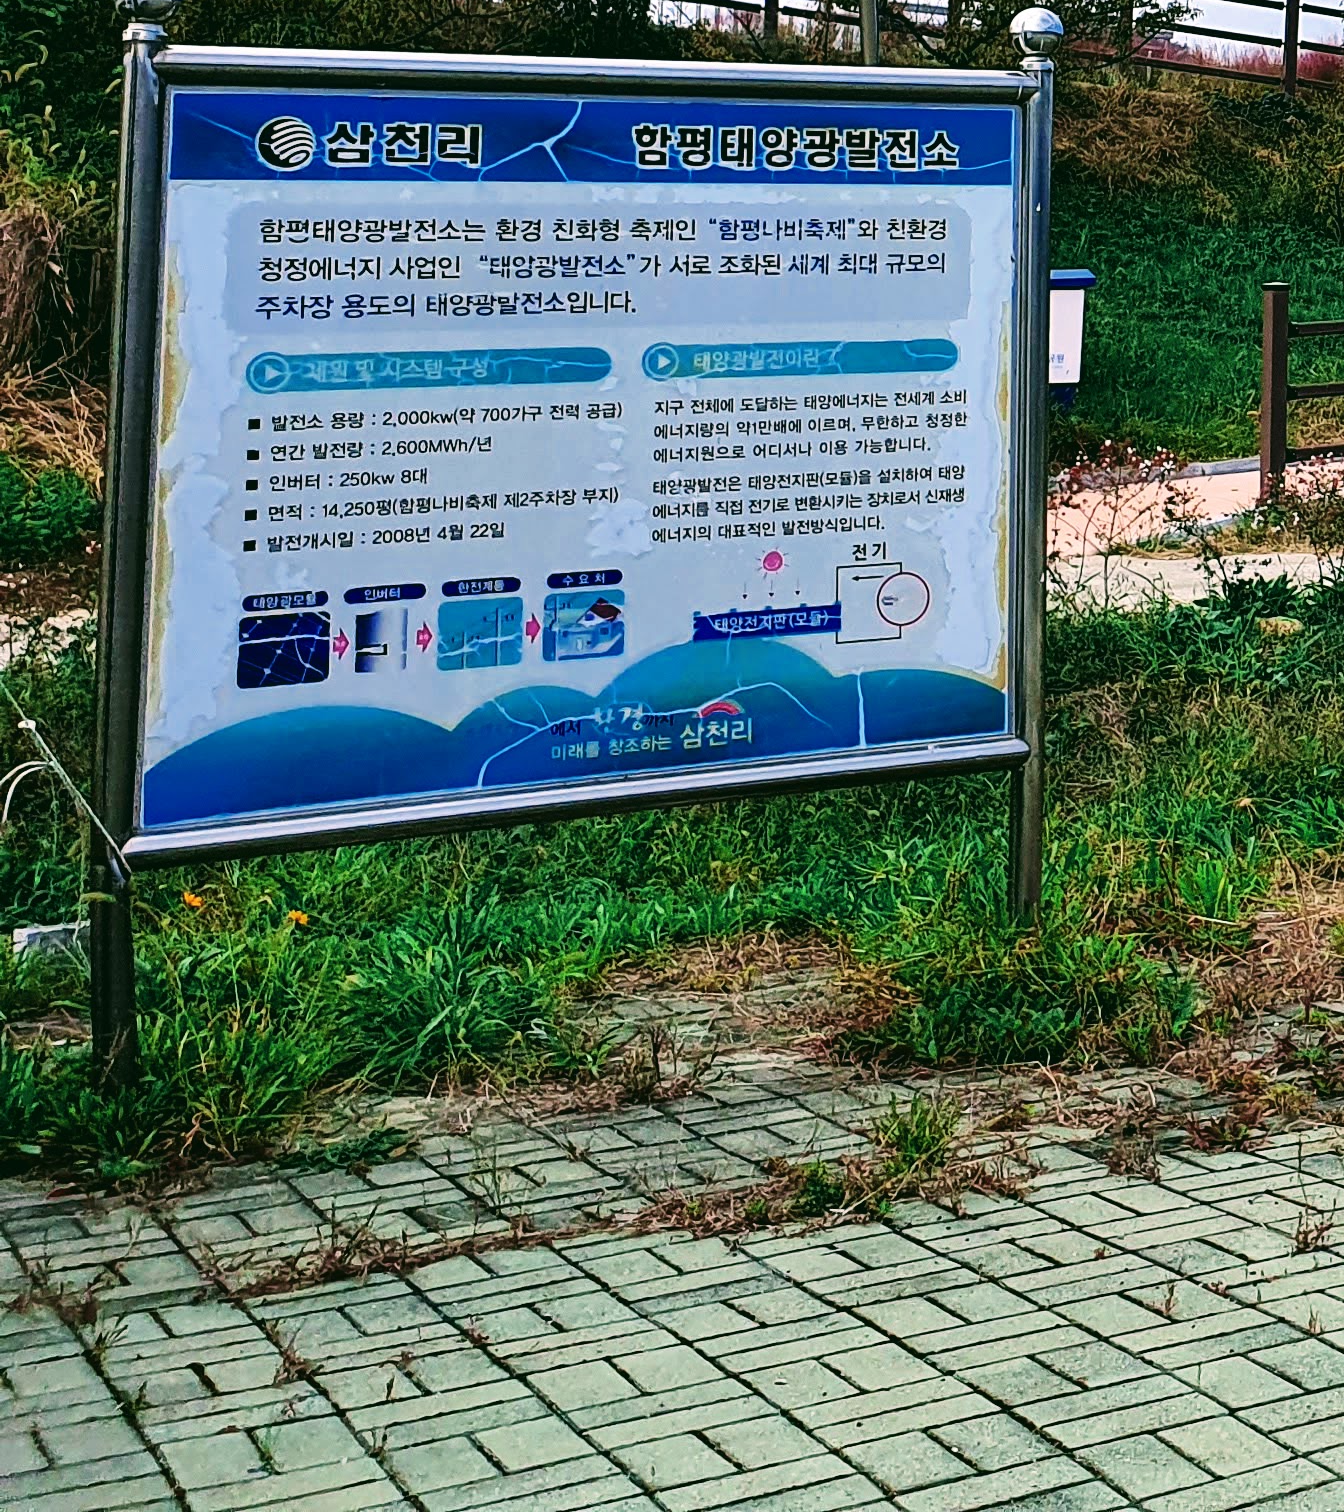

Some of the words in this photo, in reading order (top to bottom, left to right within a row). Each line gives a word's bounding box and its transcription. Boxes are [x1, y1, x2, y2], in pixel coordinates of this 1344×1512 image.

[324, 121, 482, 167] 삼천리
[633, 124, 960, 171] 함평태양광발전소
[260, 218, 486, 244] 함평태양광발전소는
[496, 219, 541, 241] 환경
[553, 218, 619, 241] 친화형
[629, 219, 696, 241] 축제인
[886, 218, 947, 240] 친환경
[259, 256, 381, 281] 청정에너지
[389, 256, 460, 280] 사업인
[669, 254, 712, 276] 서로
[718, 254, 781, 276] 조화된
[788, 253, 829, 275] 세계
[838, 253, 877, 274] 최대
[885, 253, 946, 274] 규모의
[255, 294, 334, 319] 주차장
[341, 293, 415, 319] 용도의
[272, 414, 324, 431] 발전소
[330, 411, 364, 429] 용량
[481, 406, 543, 422] 700가구
[550, 404, 579, 420] 전력
[587, 402, 622, 418] 공급)
[654, 400, 684, 416] 지구
[690, 398, 734, 414] 전체에
[740, 396, 798, 412] 도달하는
[804, 393, 888, 410] 태양에너지는
[894, 391, 934, 406] 전세계
[939, 389, 967, 404] 소비
[654, 421, 729, 439] 에너지량의
[736, 418, 801, 436] 약1만배에
[861, 414, 919, 430] 무한하고
[925, 411, 968, 428] 청정한
[271, 444, 305, 461] 연간
[313, 441, 363, 459] 발전량
[653, 445, 746, 463] 에너지원으로
[753, 441, 812, 458] 어디서나
[819, 439, 848, 455] 이용
[855, 436, 931, 454] 가능합니다.
[270, 473, 320, 491] 인버터
[340, 472, 395, 487] 250kw
[400, 467, 428, 484] 8대
[653, 475, 742, 495] 태양광발전은
[748, 469, 871, 491] 태양전지판(모듈)을
[877, 466, 933, 483] 설치하여
[938, 464, 965, 480] 태양
[268, 503, 302, 521] 면적
[503, 489, 577, 508] 제2주차장
[582, 487, 619, 504] 부지)
[652, 501, 709, 519] 에너지를
[715, 499, 743, 515] 직접
[748, 498, 790, 514] 전기로
[795, 493, 863, 511] 변환시키는
[867, 490, 920, 508] 장치로서
[925, 487, 965, 504] 신재생
[267, 531, 354, 552] 발전개시일
[372, 526, 430, 545] 2008년
[437, 524, 463, 541] 4월
[470, 522, 504, 539] 22일
[652, 524, 711, 543] 에너지의
[718, 521, 776, 539] 대표적인
[782, 515, 885, 536] 발전방식입니다.
[364, 587, 401, 601] 인버터
[551, 740, 600, 761] 미래를
[608, 735, 672, 756] 창조하는
[679, 717, 753, 750] 삼천리
